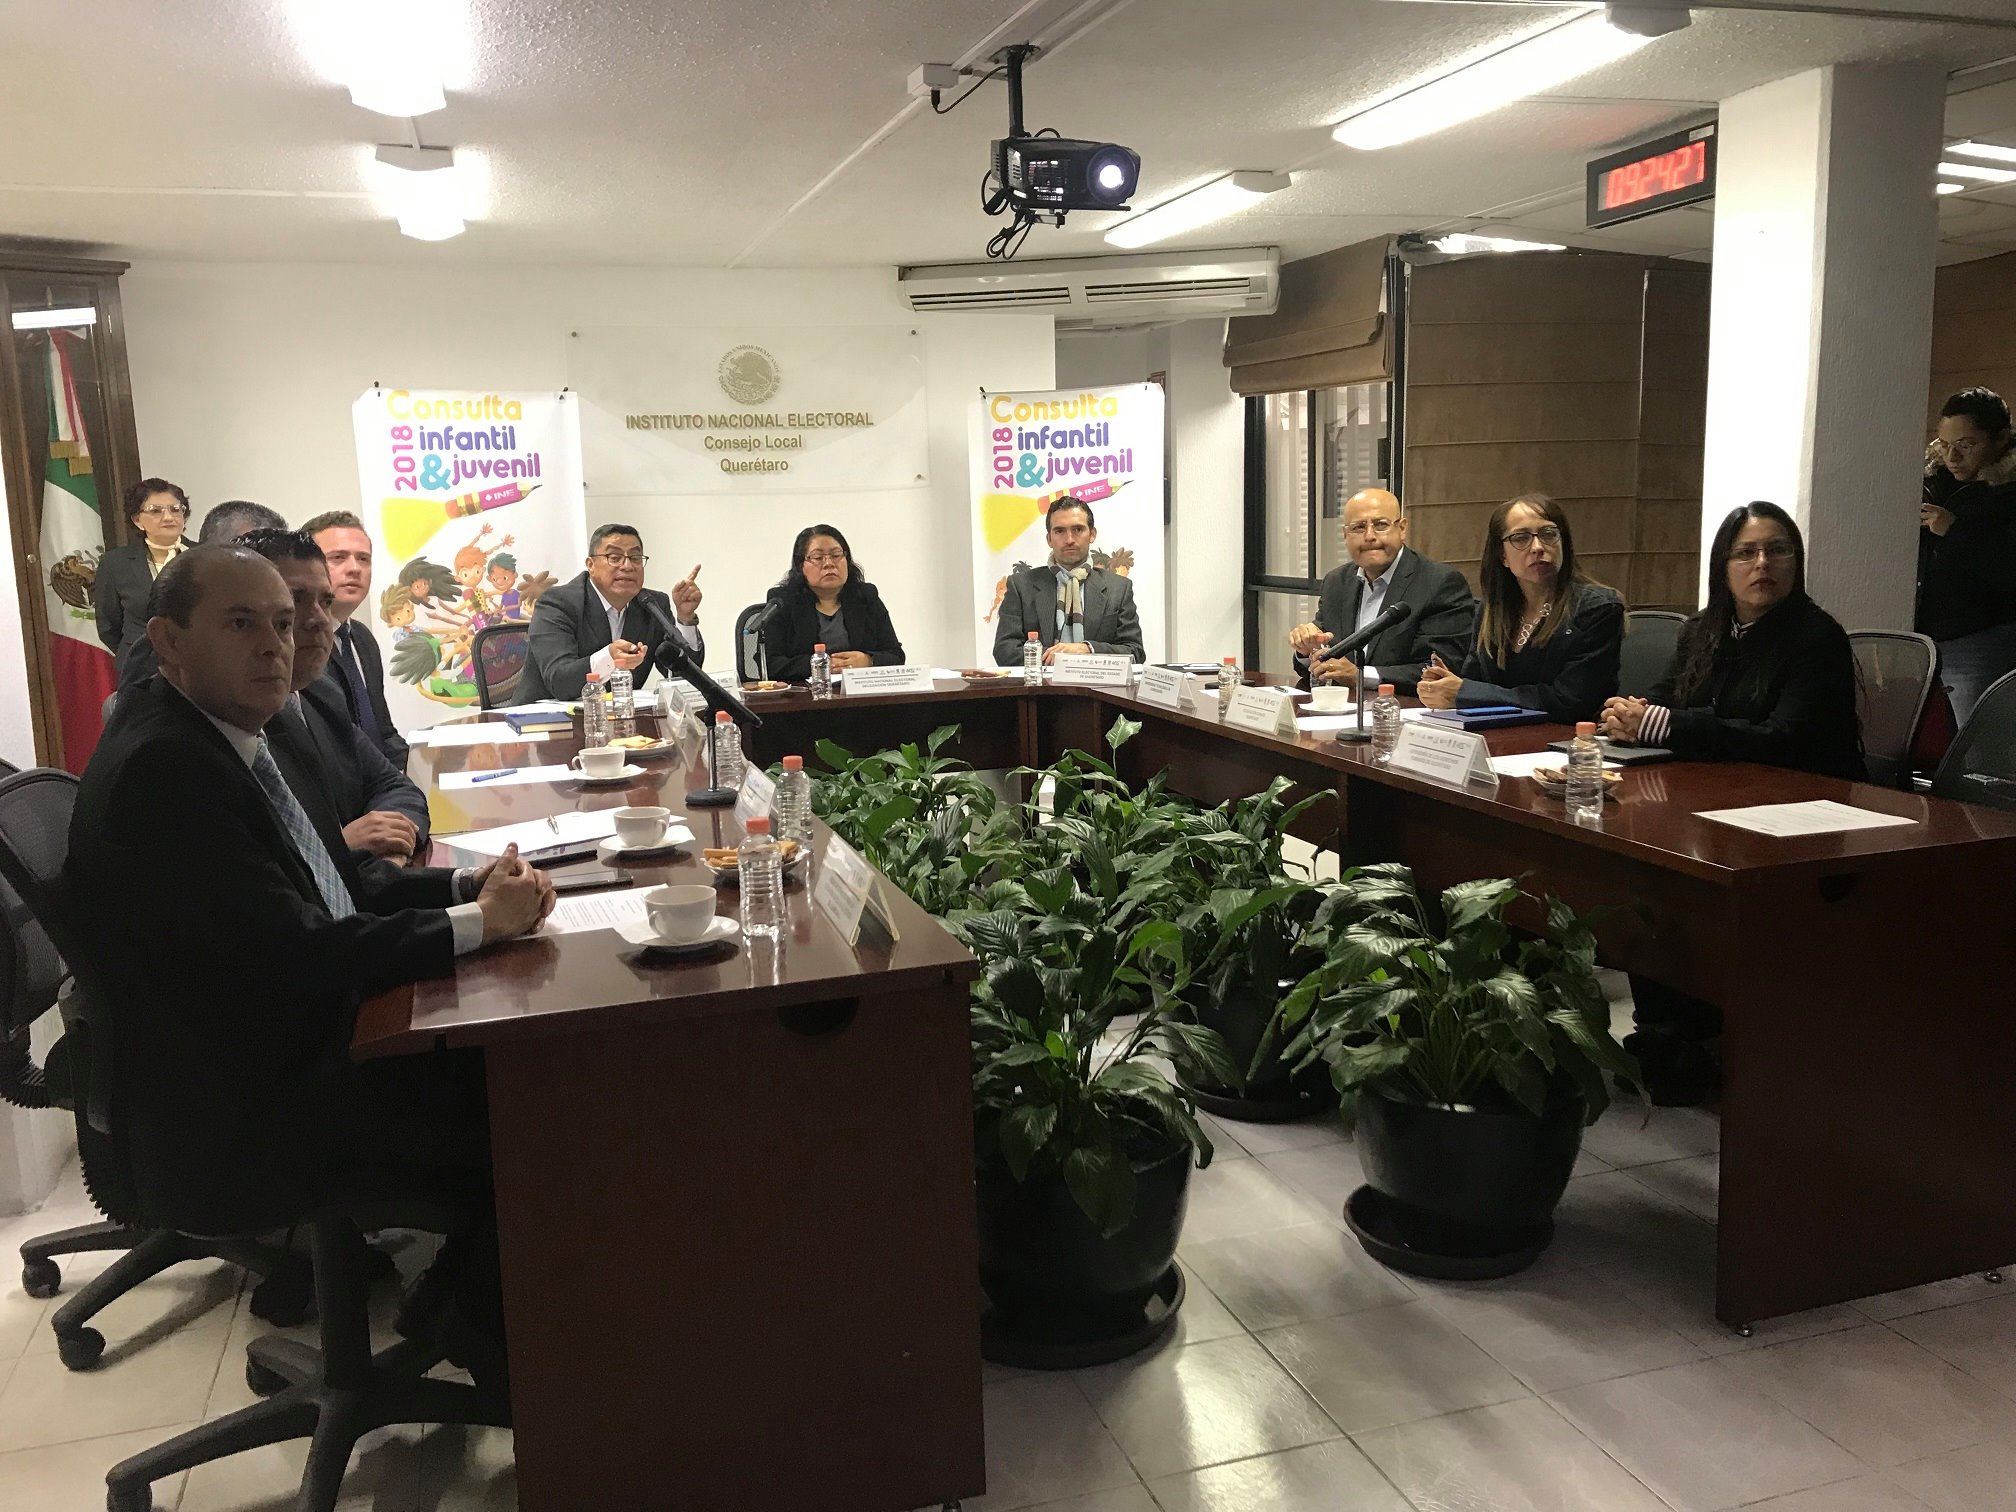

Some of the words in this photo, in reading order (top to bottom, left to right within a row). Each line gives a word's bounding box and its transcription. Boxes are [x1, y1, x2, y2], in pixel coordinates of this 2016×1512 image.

[386, 389, 522, 421] Consulta
[990, 393, 1119, 423] Consulta
[625, 414, 703, 429] INSTITUTO
[707, 413, 783, 428] NACIONAL
[787, 412, 874, 427] ELECTORAL
[419, 425, 516, 451] infantil
[704, 435, 761, 452] Consejo
[765, 434, 802, 449] Local
[1017, 422, 1109, 451] infantil
[390, 425, 418, 491] 2018
[720, 458, 789, 474] Querétaro
[992, 426, 1014, 488] 2018
[493, 488, 515, 501] INE
[1084, 484, 1105, 496] INE
